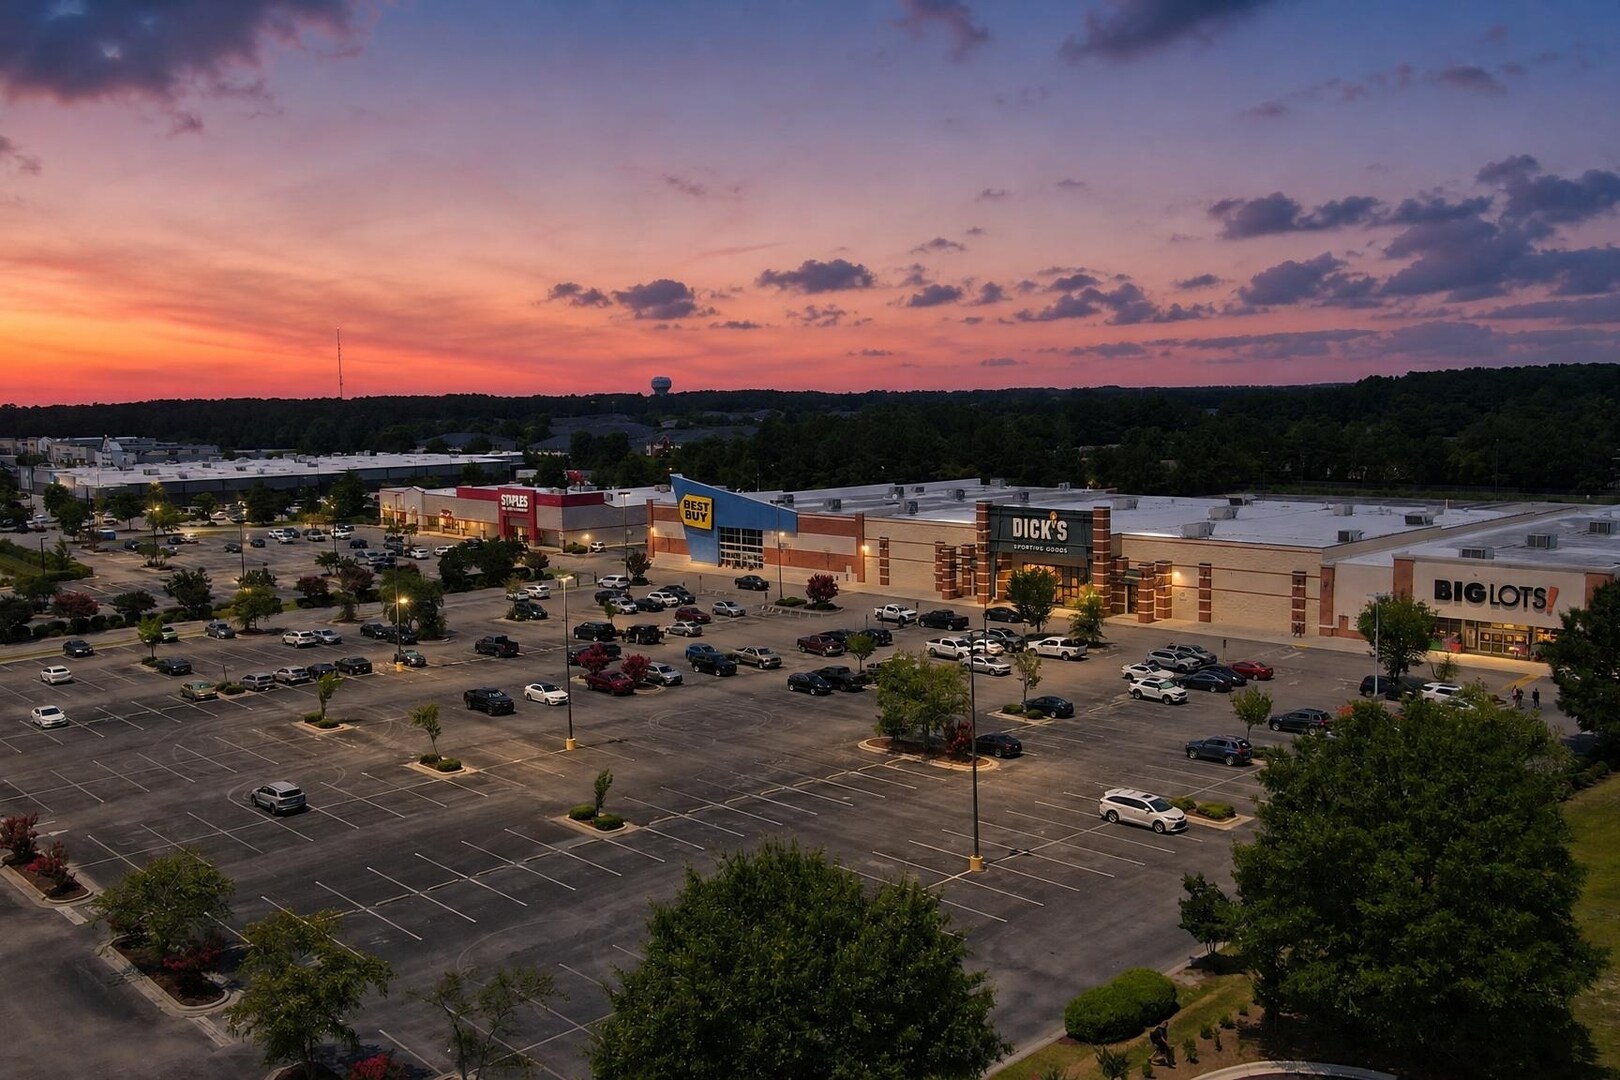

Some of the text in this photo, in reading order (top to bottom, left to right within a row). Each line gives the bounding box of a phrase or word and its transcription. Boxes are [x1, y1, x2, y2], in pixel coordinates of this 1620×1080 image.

[501, 494, 528, 508] STAPLES
[684, 500, 710, 512] BEST
[685, 510, 708, 522] BUY
[1012, 511, 1068, 541] DICK'S
[1434, 579, 1487, 603] BIG
